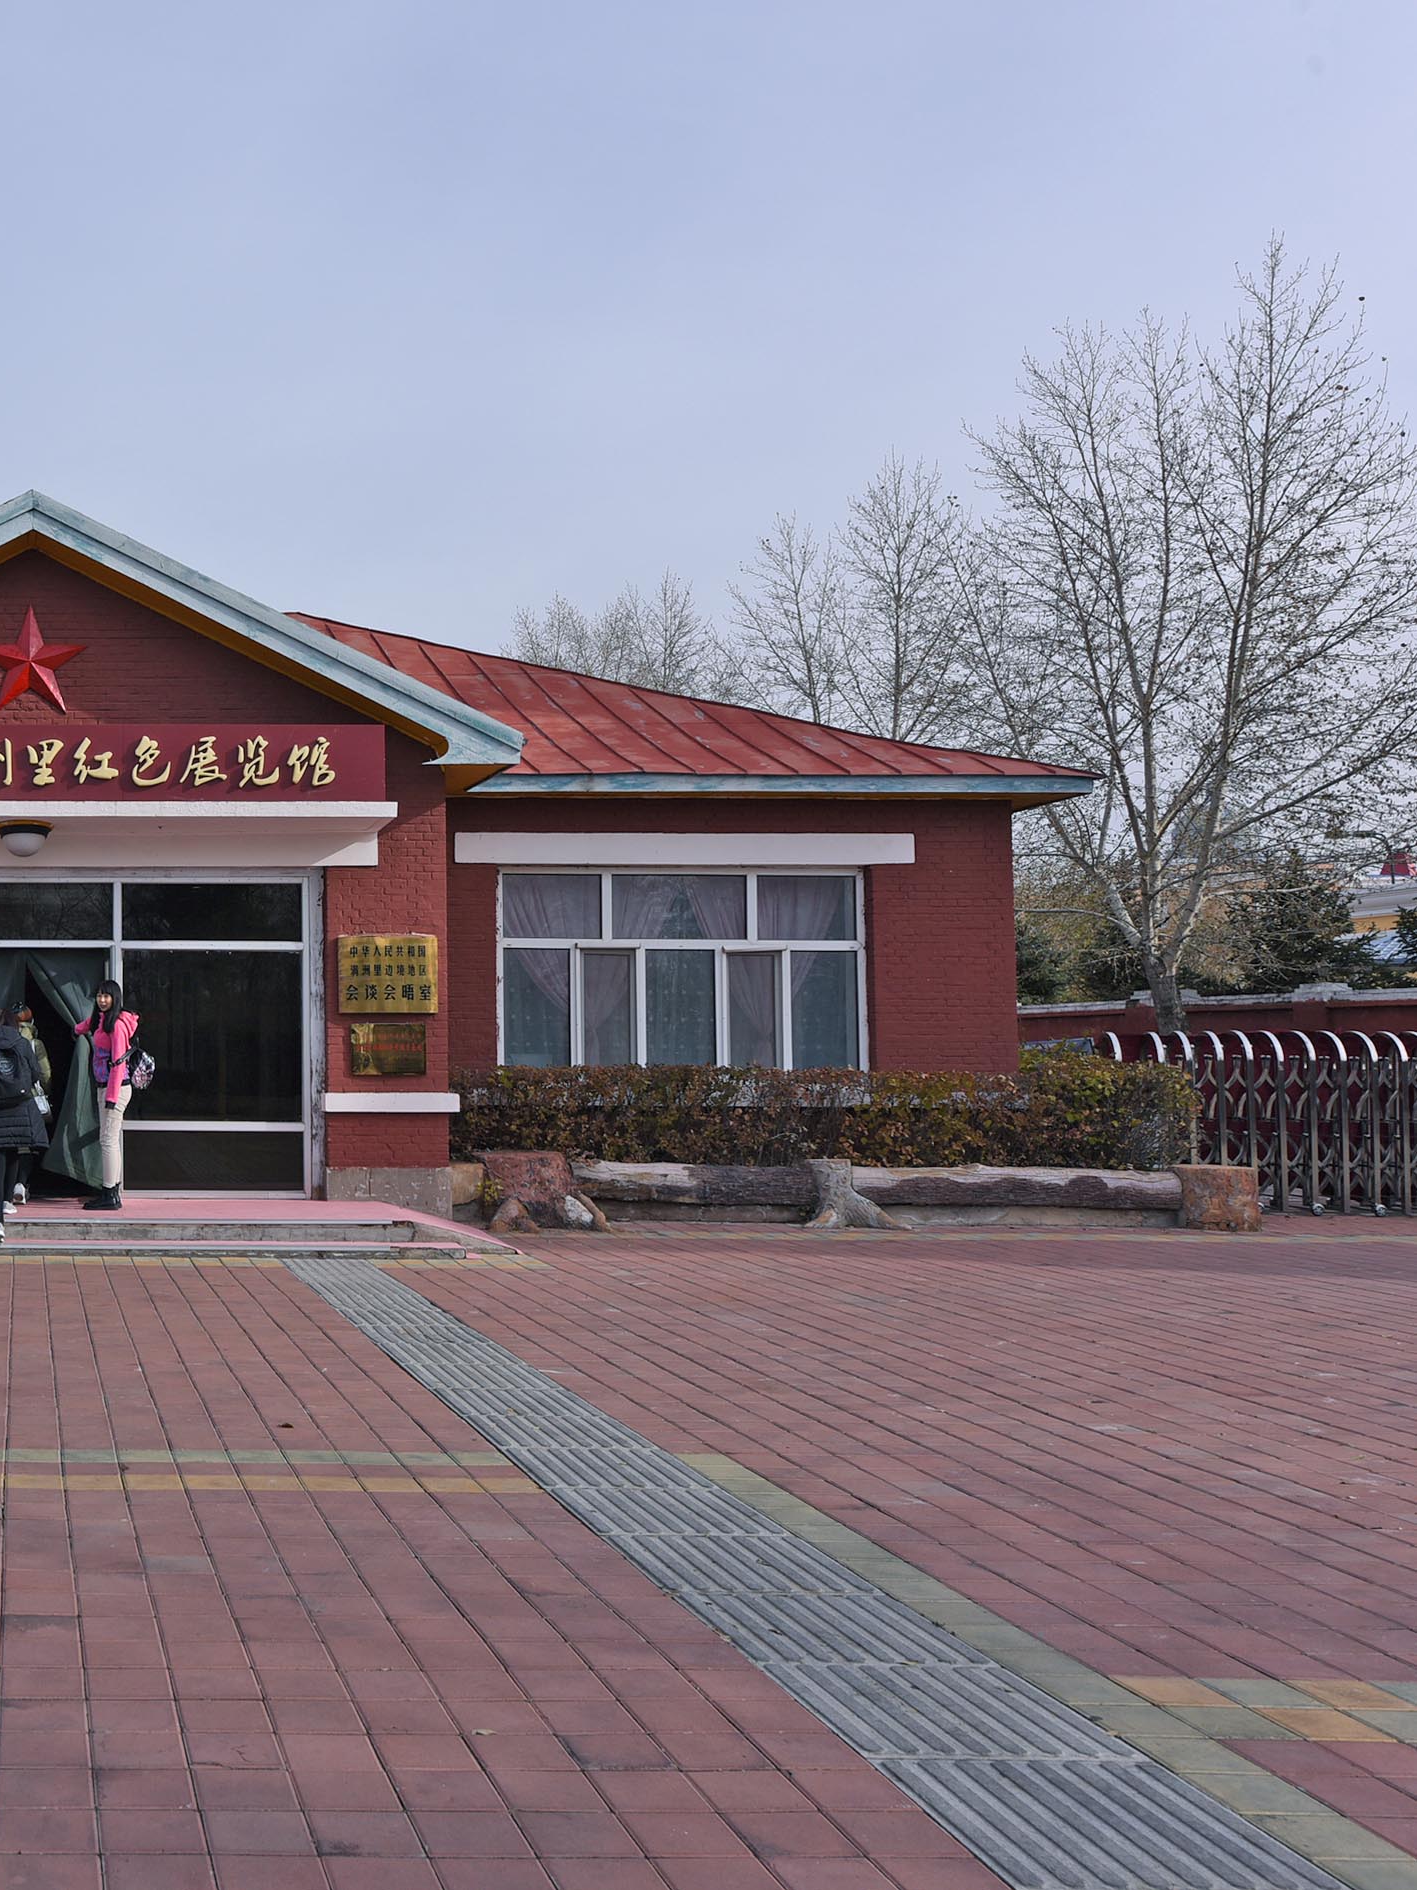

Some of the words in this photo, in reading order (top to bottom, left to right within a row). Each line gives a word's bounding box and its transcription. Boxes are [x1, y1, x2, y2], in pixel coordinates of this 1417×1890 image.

[349, 944, 426, 957] 中华人民共和国
[350, 963, 427, 977] 满洲里边境地区
[345, 984, 432, 1001] 会谈会晤室
